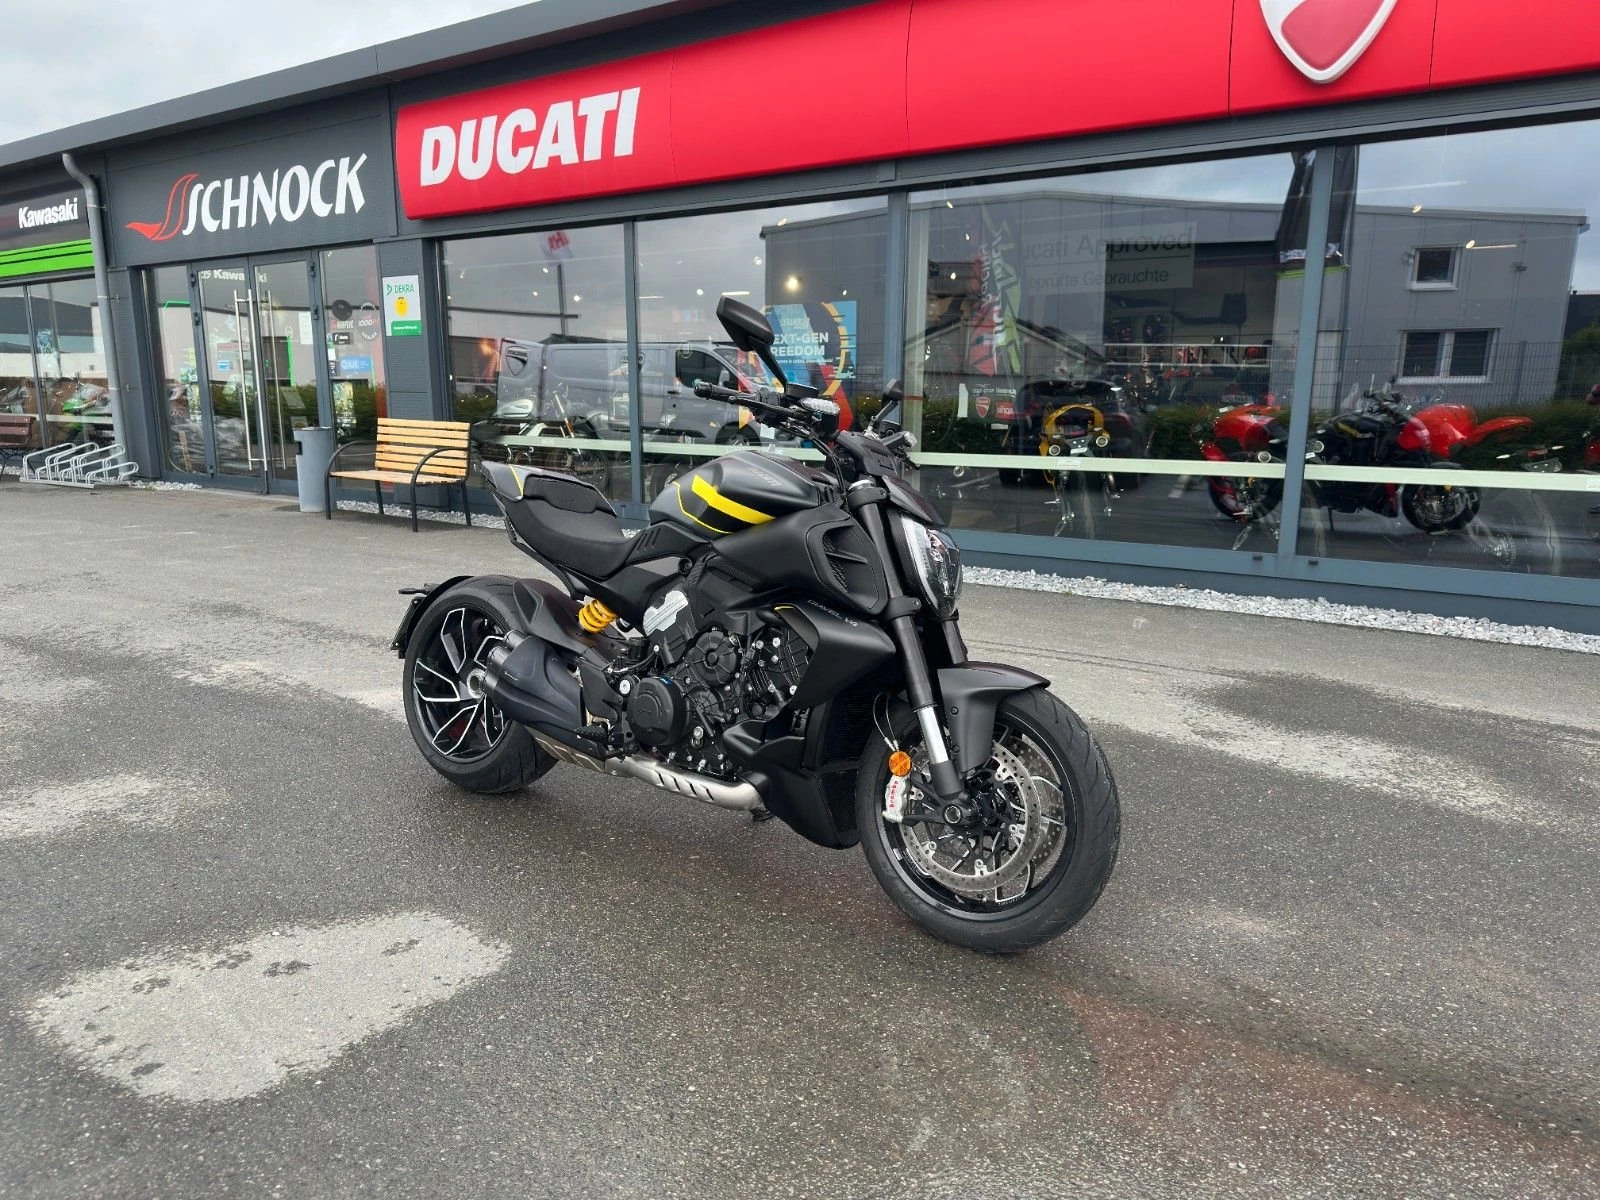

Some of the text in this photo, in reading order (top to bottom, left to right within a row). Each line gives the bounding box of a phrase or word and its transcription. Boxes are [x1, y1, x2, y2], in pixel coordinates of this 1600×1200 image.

[420, 87, 640, 187] DUCATI
[182, 153, 367, 236] SCHNOCK
[18, 197, 79, 229] Kawasaki
[1024, 226, 1193, 260] cati Approved
[213, 269, 268, 283] Kawaki
[1029, 267, 1169, 289] eprüfte Gebrauchte
[394, 283, 415, 294] DEKRA
[773, 332, 829, 346] EXT-GEN
[770, 345, 825, 357] REEDOM
